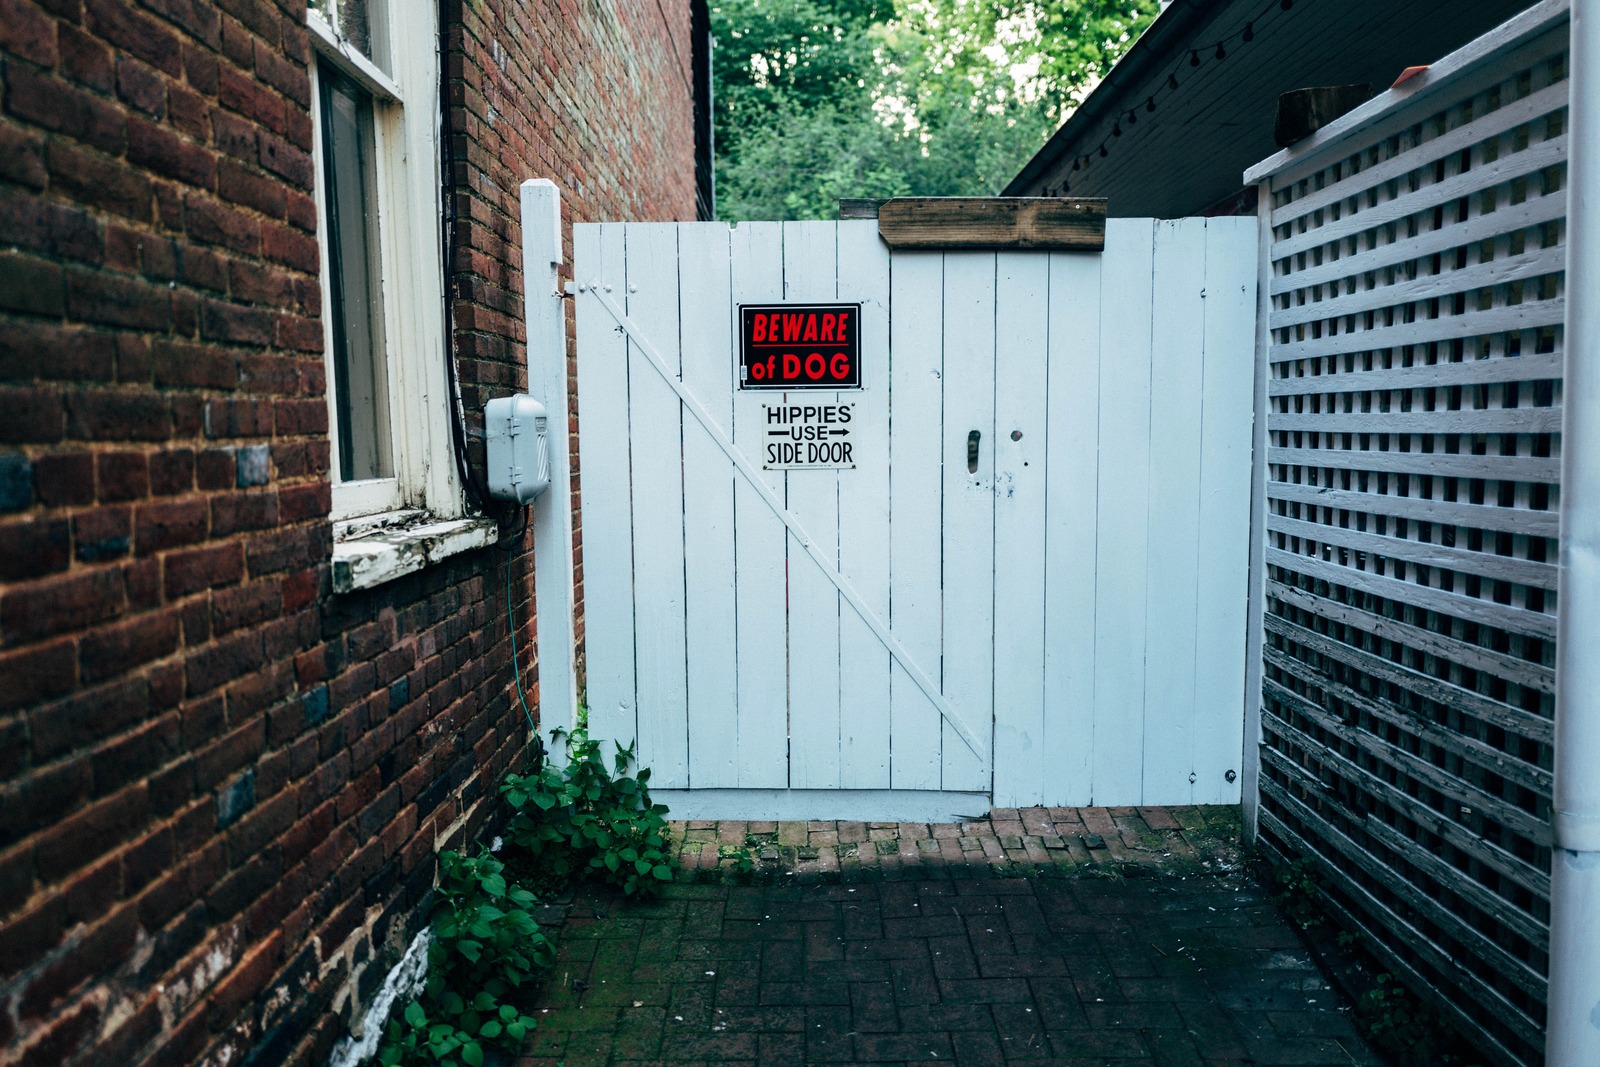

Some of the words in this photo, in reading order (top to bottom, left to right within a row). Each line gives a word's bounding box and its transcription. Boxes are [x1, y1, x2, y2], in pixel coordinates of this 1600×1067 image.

[752, 313, 849, 342] BEWARE
[751, 355, 776, 380] of
[782, 352, 850, 380] DOG
[767, 405, 852, 424] HIPPIES
[791, 425, 828, 441] USE
[767, 442, 803, 464] SIDE
[808, 441, 853, 464] DOOR
